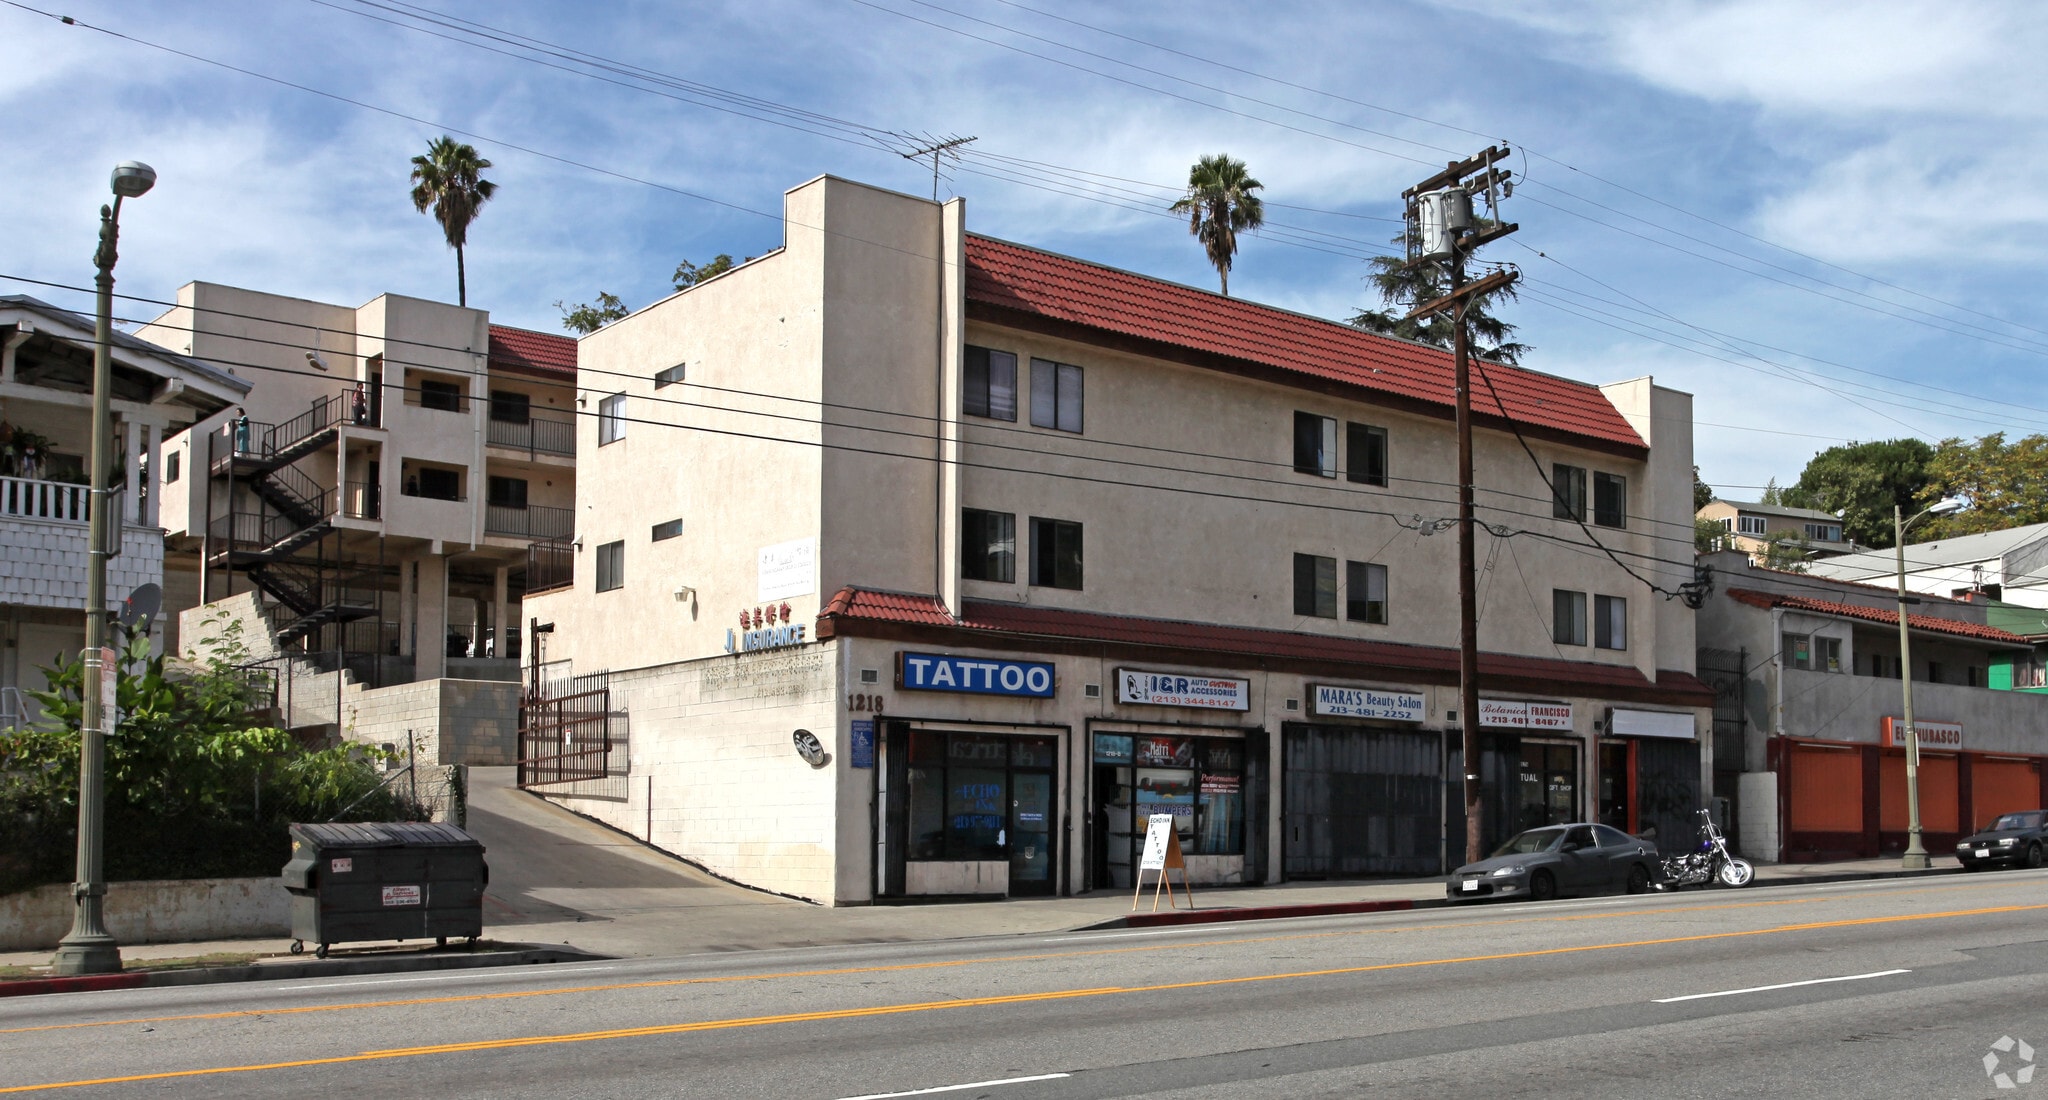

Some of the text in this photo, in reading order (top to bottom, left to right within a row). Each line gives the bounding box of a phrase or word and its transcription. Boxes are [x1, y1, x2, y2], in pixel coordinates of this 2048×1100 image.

[742, 624, 805, 651] INSURANCE
[909, 659, 1050, 692] TATTOO
[1190, 687, 1237, 697] ACCESSORIES
[1320, 688, 1421, 709] MARA'S Beauty Salon
[848, 694, 883, 712] 1218
[1152, 695, 1236, 707] (213) 344-8147
[1329, 706, 1412, 719] 213-481-2252
[1531, 706, 1570, 717] FRANCISCO
[1895, 726, 1960, 744] EL HUBASCO
[1520, 773, 1538, 782] TUAL
[1153, 805, 1191, 816] BUMPERS
